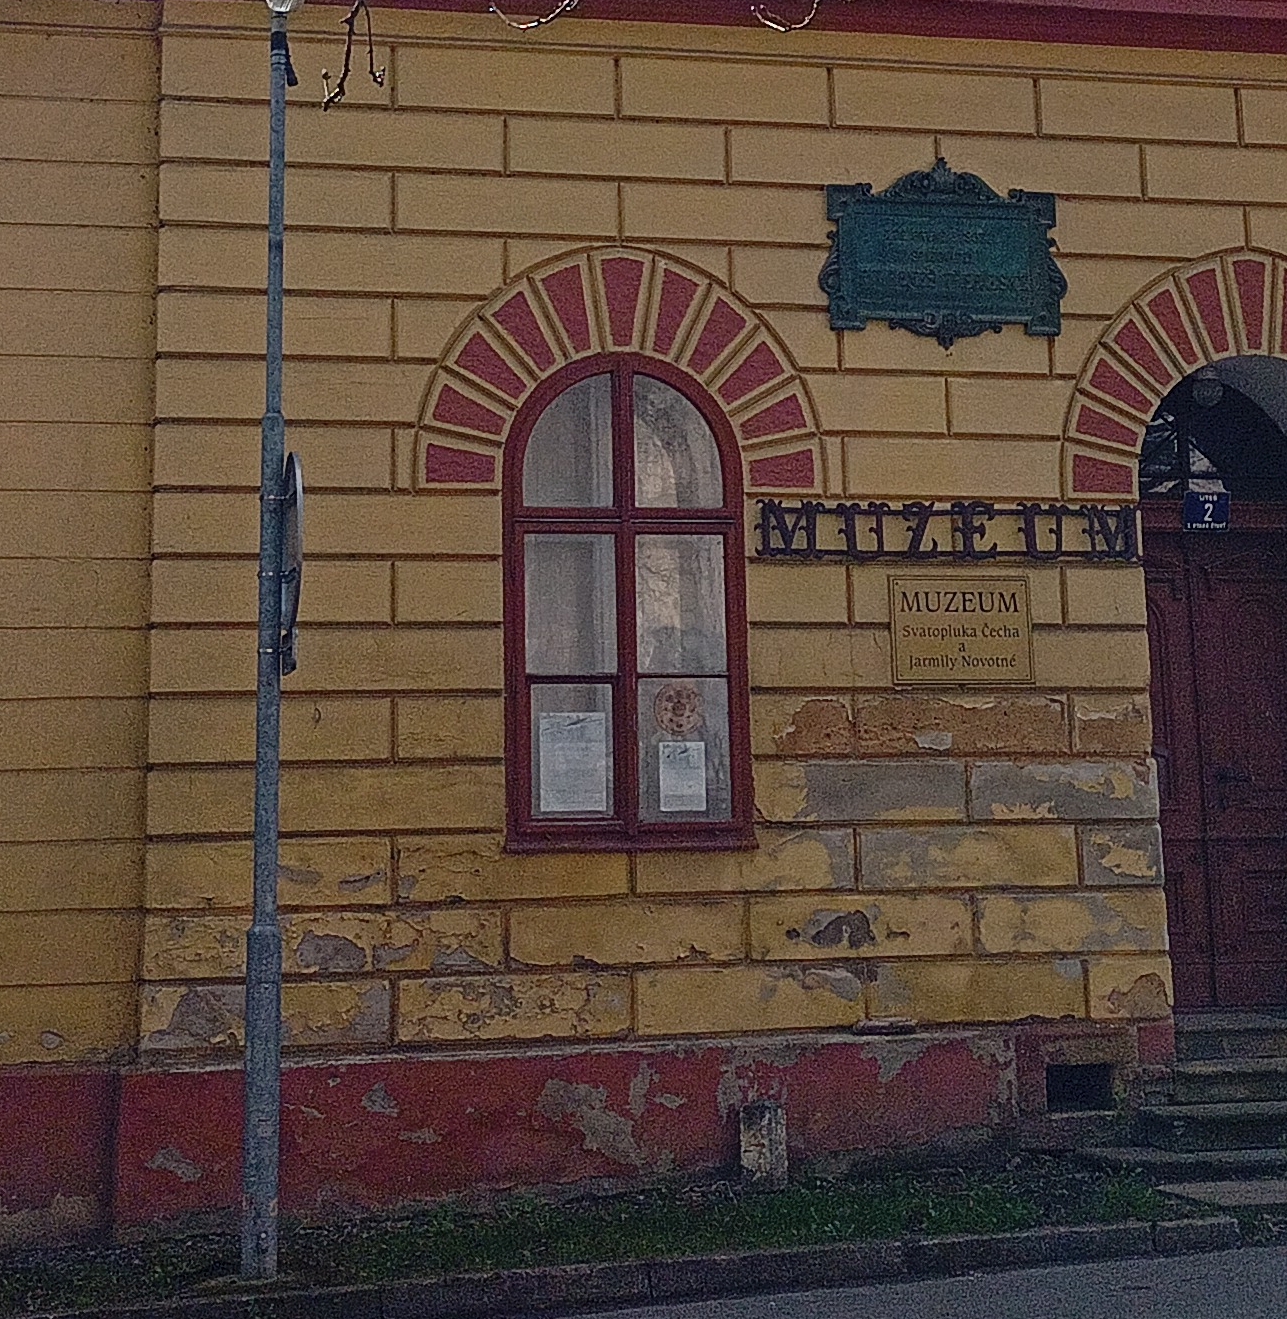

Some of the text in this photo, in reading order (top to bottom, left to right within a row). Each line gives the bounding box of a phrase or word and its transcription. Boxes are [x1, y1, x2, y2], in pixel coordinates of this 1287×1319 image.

[1203, 502, 1214, 522] 2
[754, 499, 1136, 561] MUZEUM
[900, 590, 1020, 613] MUZEUM
[902, 623, 1020, 641] Svatopluka Čecha
[958, 642, 966, 653] a
[909, 654, 1017, 671] Jarmily Novotné
